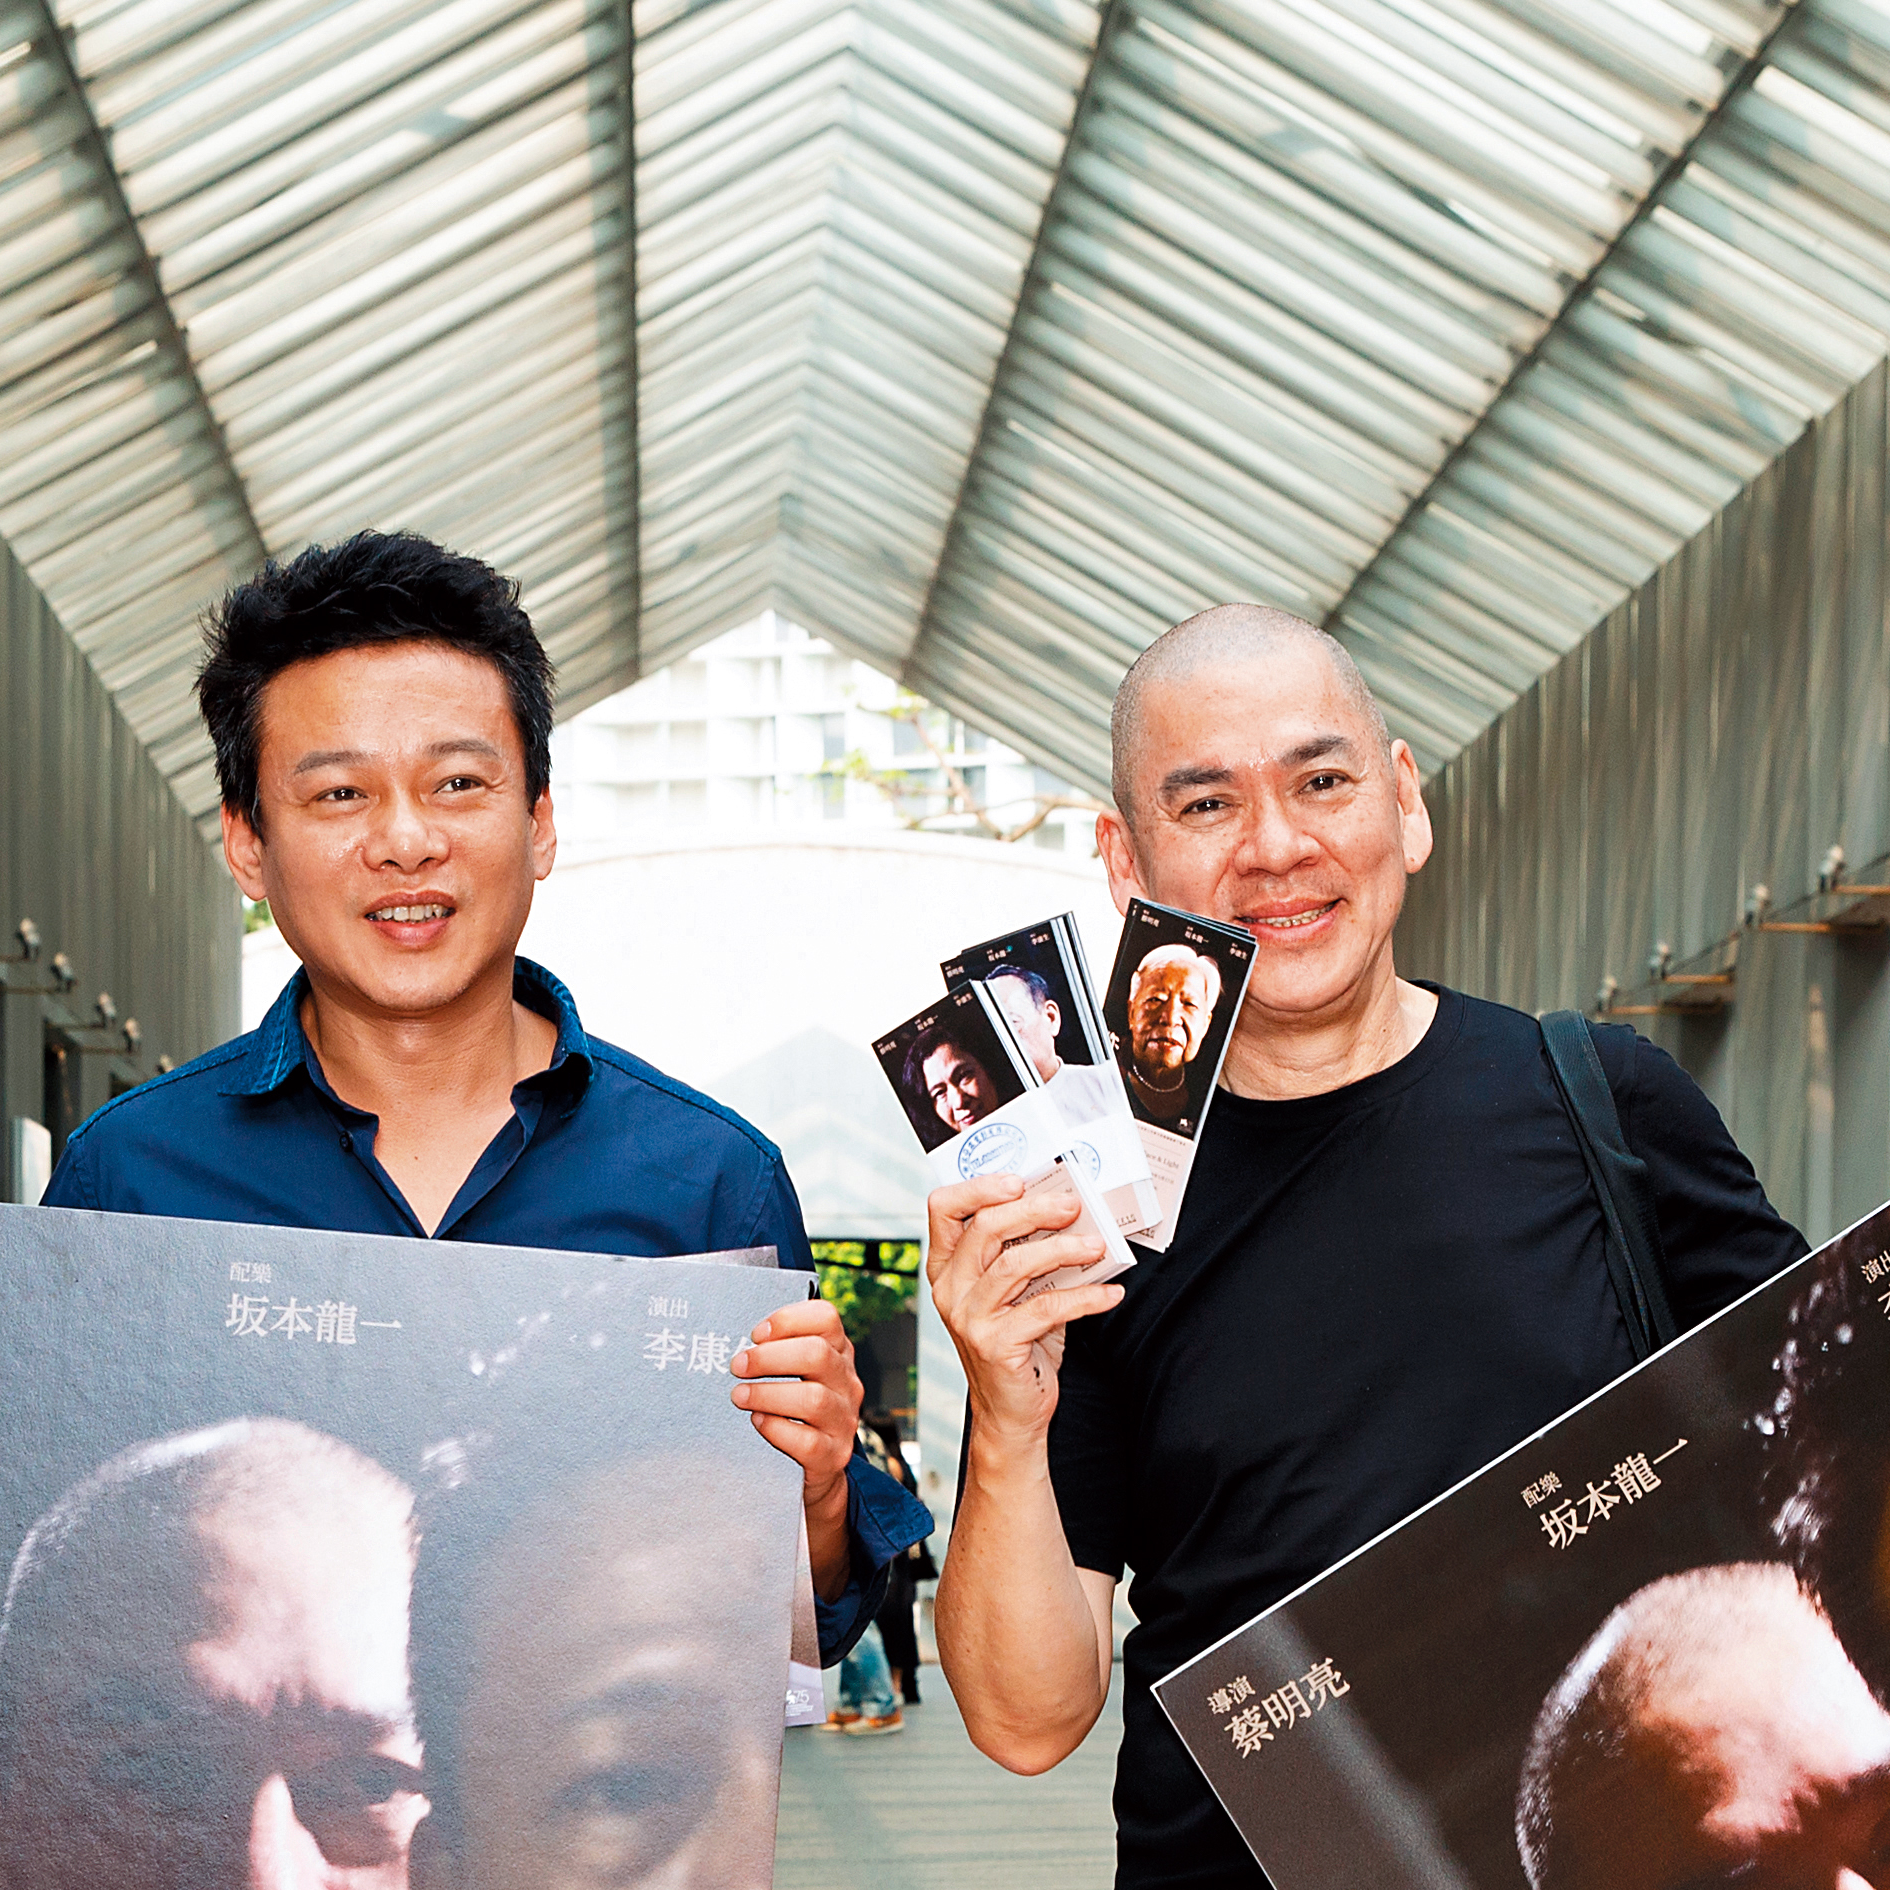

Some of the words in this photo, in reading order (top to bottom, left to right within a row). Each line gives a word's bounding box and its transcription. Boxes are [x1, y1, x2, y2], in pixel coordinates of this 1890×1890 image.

[229, 1259, 272, 1284] 配樂
[224, 1291, 403, 1349] 坂本龍一
[646, 1295, 689, 1319] 演出
[641, 1326, 756, 1378] 李康
[1520, 1471, 1562, 1508] 配樂
[1540, 1438, 1687, 1548] 坂本龍一
[1207, 1675, 1255, 1714] 導演
[1224, 1658, 1349, 1757] 蔡明亮
